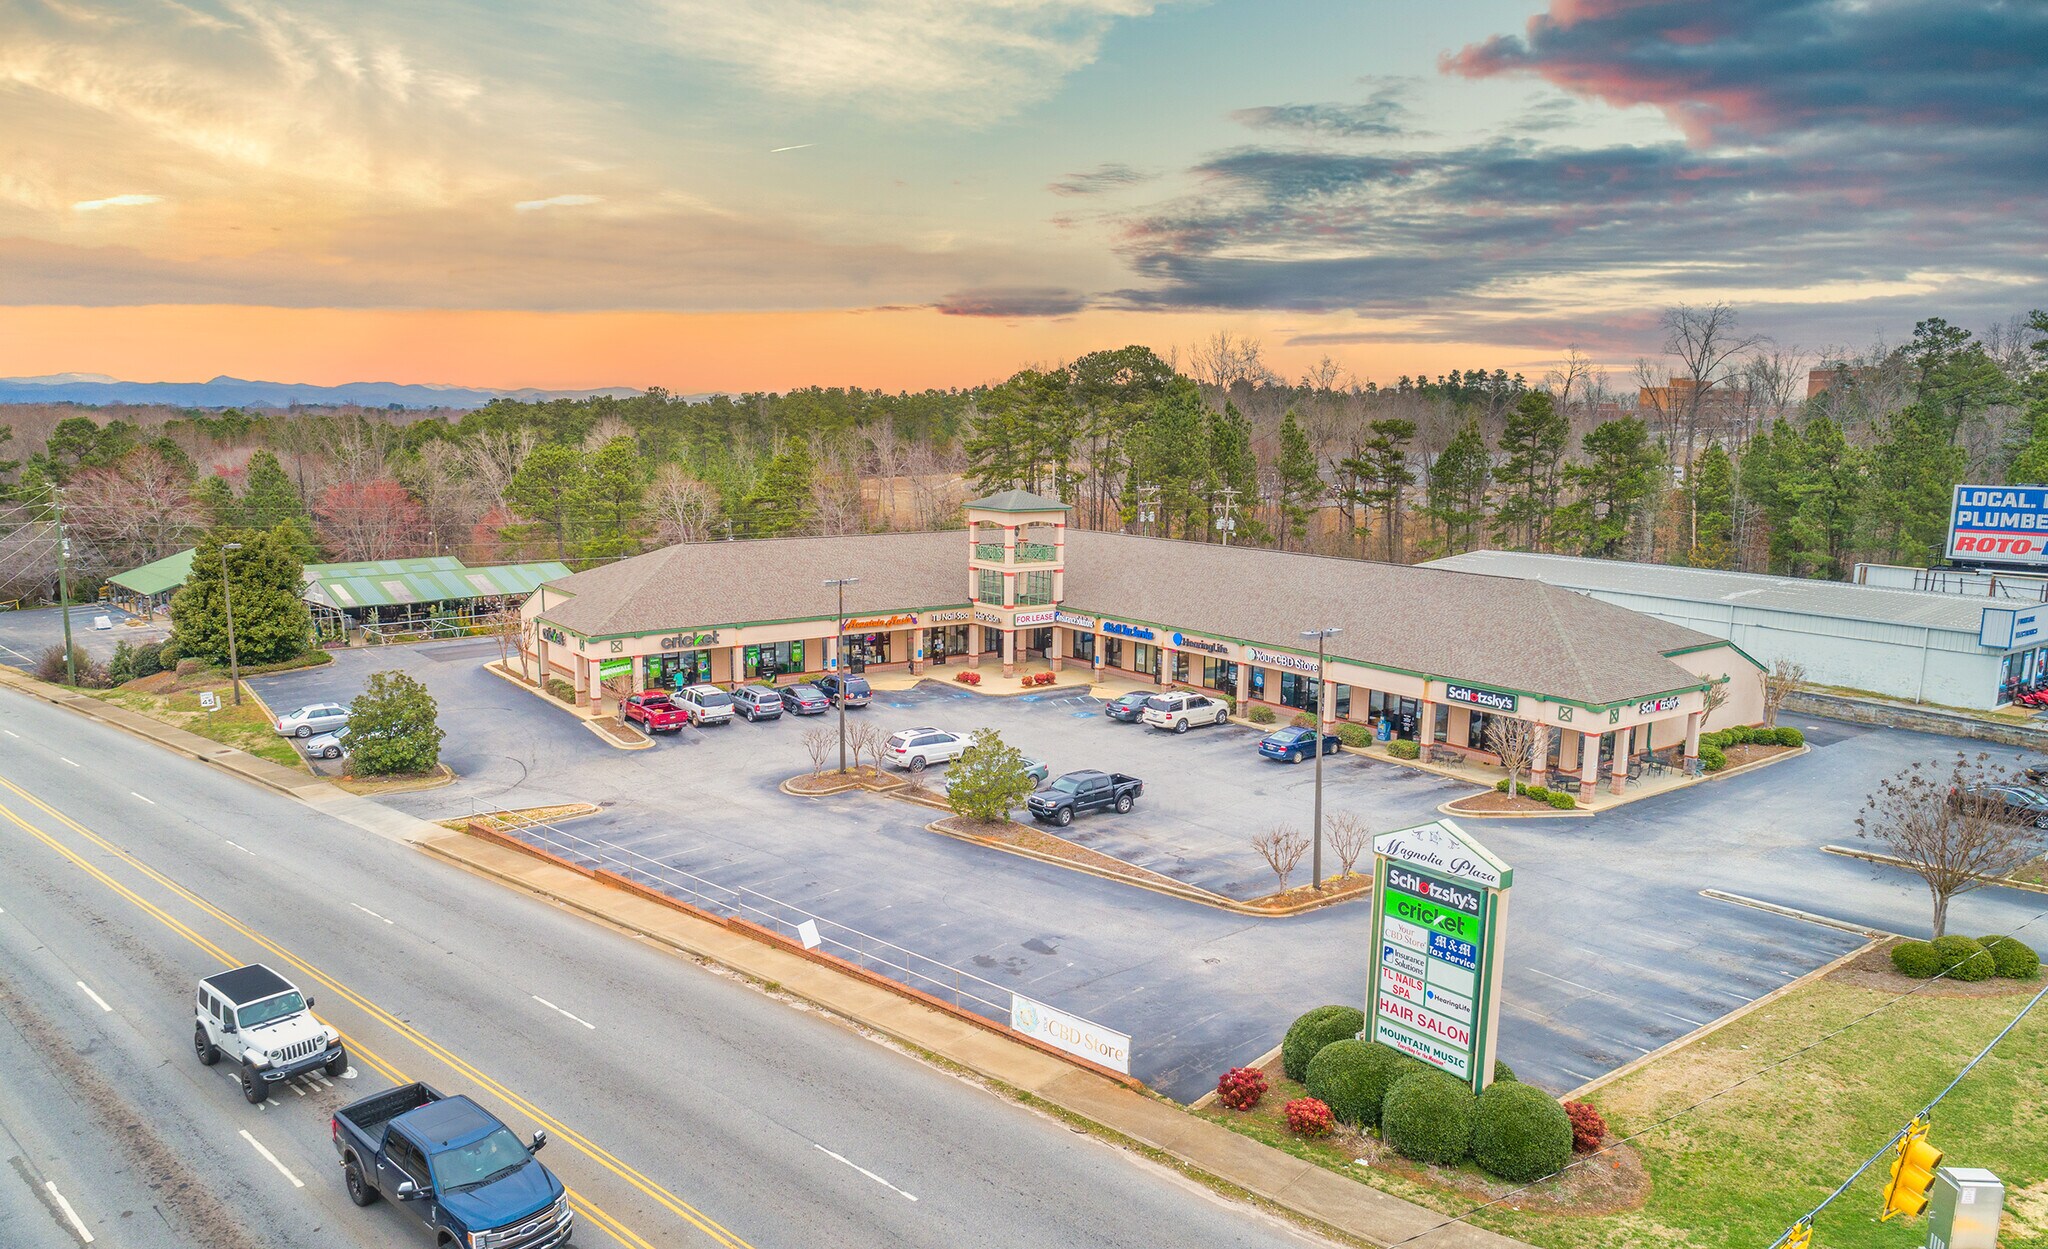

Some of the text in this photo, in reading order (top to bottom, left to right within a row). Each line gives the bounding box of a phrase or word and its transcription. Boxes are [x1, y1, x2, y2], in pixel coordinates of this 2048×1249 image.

[1959, 490, 2036, 509] LOCAL.
[1016, 613, 1053, 624] FOR LEASE
[661, 630, 719, 650] cricket
[1182, 637, 1228, 654] HearingLife
[1256, 650, 1319, 673] Your CBD Store
[1448, 686, 1513, 709] Schlotzsky's
[1377, 838, 1496, 882] Magnolia Plaza
[1389, 869, 1478, 911] Schlotzsky's
[1397, 901, 1465, 935] cricket
[1385, 928, 1403, 941] CBD
[1398, 924, 1415, 936] Your
[1394, 949, 1425, 967] Insurance
[1394, 958, 1424, 975] Solutions
[1429, 945, 1476, 969] Tax Service
[1383, 967, 1423, 991] TL NAILS
[1392, 984, 1411, 999] SPA
[1434, 994, 1471, 1013] HearingLife
[1379, 998, 1469, 1045] HAIR SALON
[1048, 1020, 1081, 1045] CBD
[1084, 1032, 1124, 1061] Store
[1379, 1025, 1465, 1069] MOUNTAIN MUSIC
